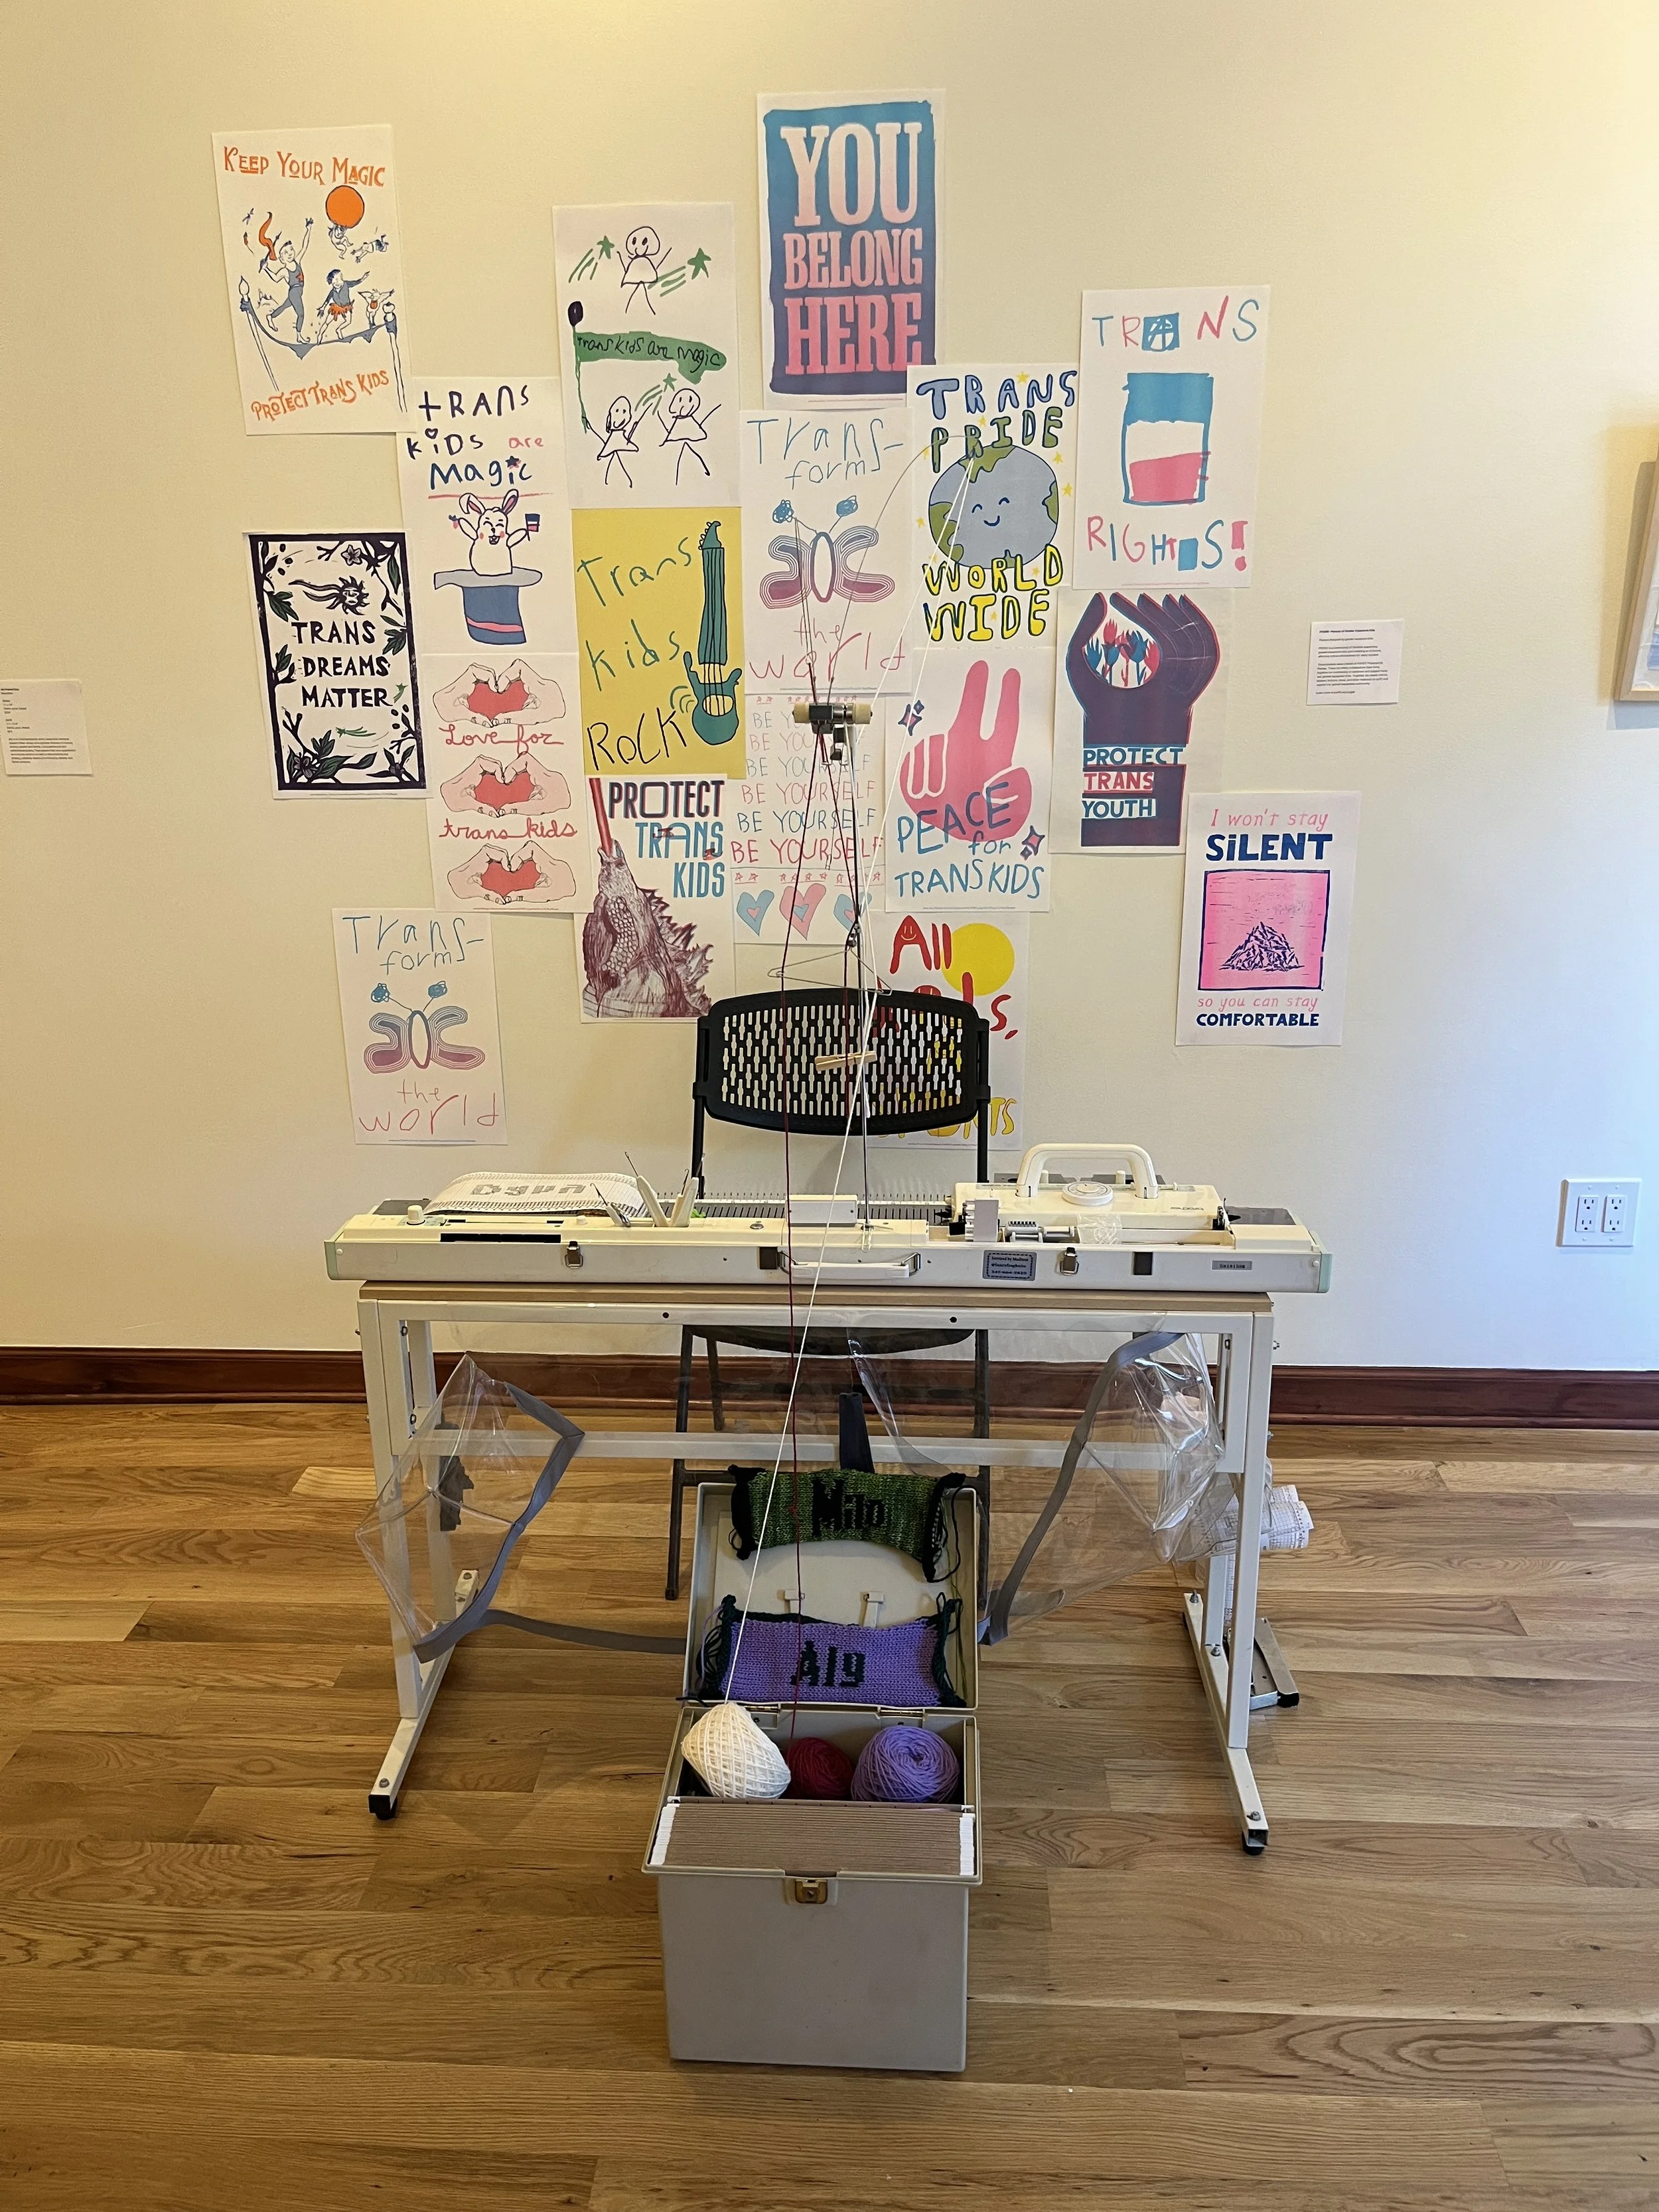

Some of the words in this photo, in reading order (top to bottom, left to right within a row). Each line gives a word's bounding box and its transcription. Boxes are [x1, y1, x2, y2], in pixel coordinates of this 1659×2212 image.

[224, 147, 269, 174] KEEP
[277, 151, 325, 185] YOUR
[333, 157, 385, 186] MAGIC
[780, 122, 922, 227] YOU
[782, 228, 923, 290] BELONG
[784, 293, 922, 375] HERE
[252, 390, 310, 421] PROTECT
[309, 378, 357, 406] TRANS
[357, 370, 390, 394] KIDS
[916, 370, 1078, 420] TRANS
[509, 437, 543, 449] are
[930, 406, 1063, 474] PRIDE
[577, 537, 691, 607] Trans
[922, 544, 1063, 597] WORLD
[794, 615, 841, 645] the
[923, 589, 1050, 642] WIDE
[291, 621, 376, 645] TRANS
[302, 654, 391, 678] DREAMS
[749, 632, 906, 682] world
[301, 685, 393, 708] MATTER
[753, 711, 772, 729] BE
[439, 724, 499, 746] Love
[516, 724, 564, 757] for
[750, 733, 770, 751] BE
[746, 757, 768, 776] BE
[1083, 747, 1185, 766] PROTECT
[741, 784, 766, 804] BE
[776, 780, 876, 804] YOURSELF
[1084, 772, 1153, 790] TRANS
[609, 780, 725, 819] PROTECT
[1082, 799, 1153, 818] YOUTH
[439, 818, 509, 840] trans
[524, 817, 577, 839] kids
[737, 812, 762, 832] BE
[897, 781, 1011, 855] PEACE
[1210, 809, 1219, 826] I
[1228, 808, 1279, 826] won't
[1287, 812, 1329, 832] stay
[635, 822, 724, 859] TRANS
[731, 840, 758, 863] BE
[770, 837, 883, 863] YOURSELF
[968, 830, 1011, 855] for
[673, 862, 725, 898] KIDS
[895, 859, 983, 897] TRANS
[988, 862, 1045, 899] KIDS
[889, 915, 952, 974] All
[1197, 996, 1213, 1007] so
[1218, 996, 1246, 1011] you
[1253, 996, 1279, 1007] can
[1285, 995, 1318, 1011] stay
[1196, 1013, 1319, 1027] COMFORTABLE
[397, 1079, 441, 1104] the
[359, 1092, 499, 1135] world
